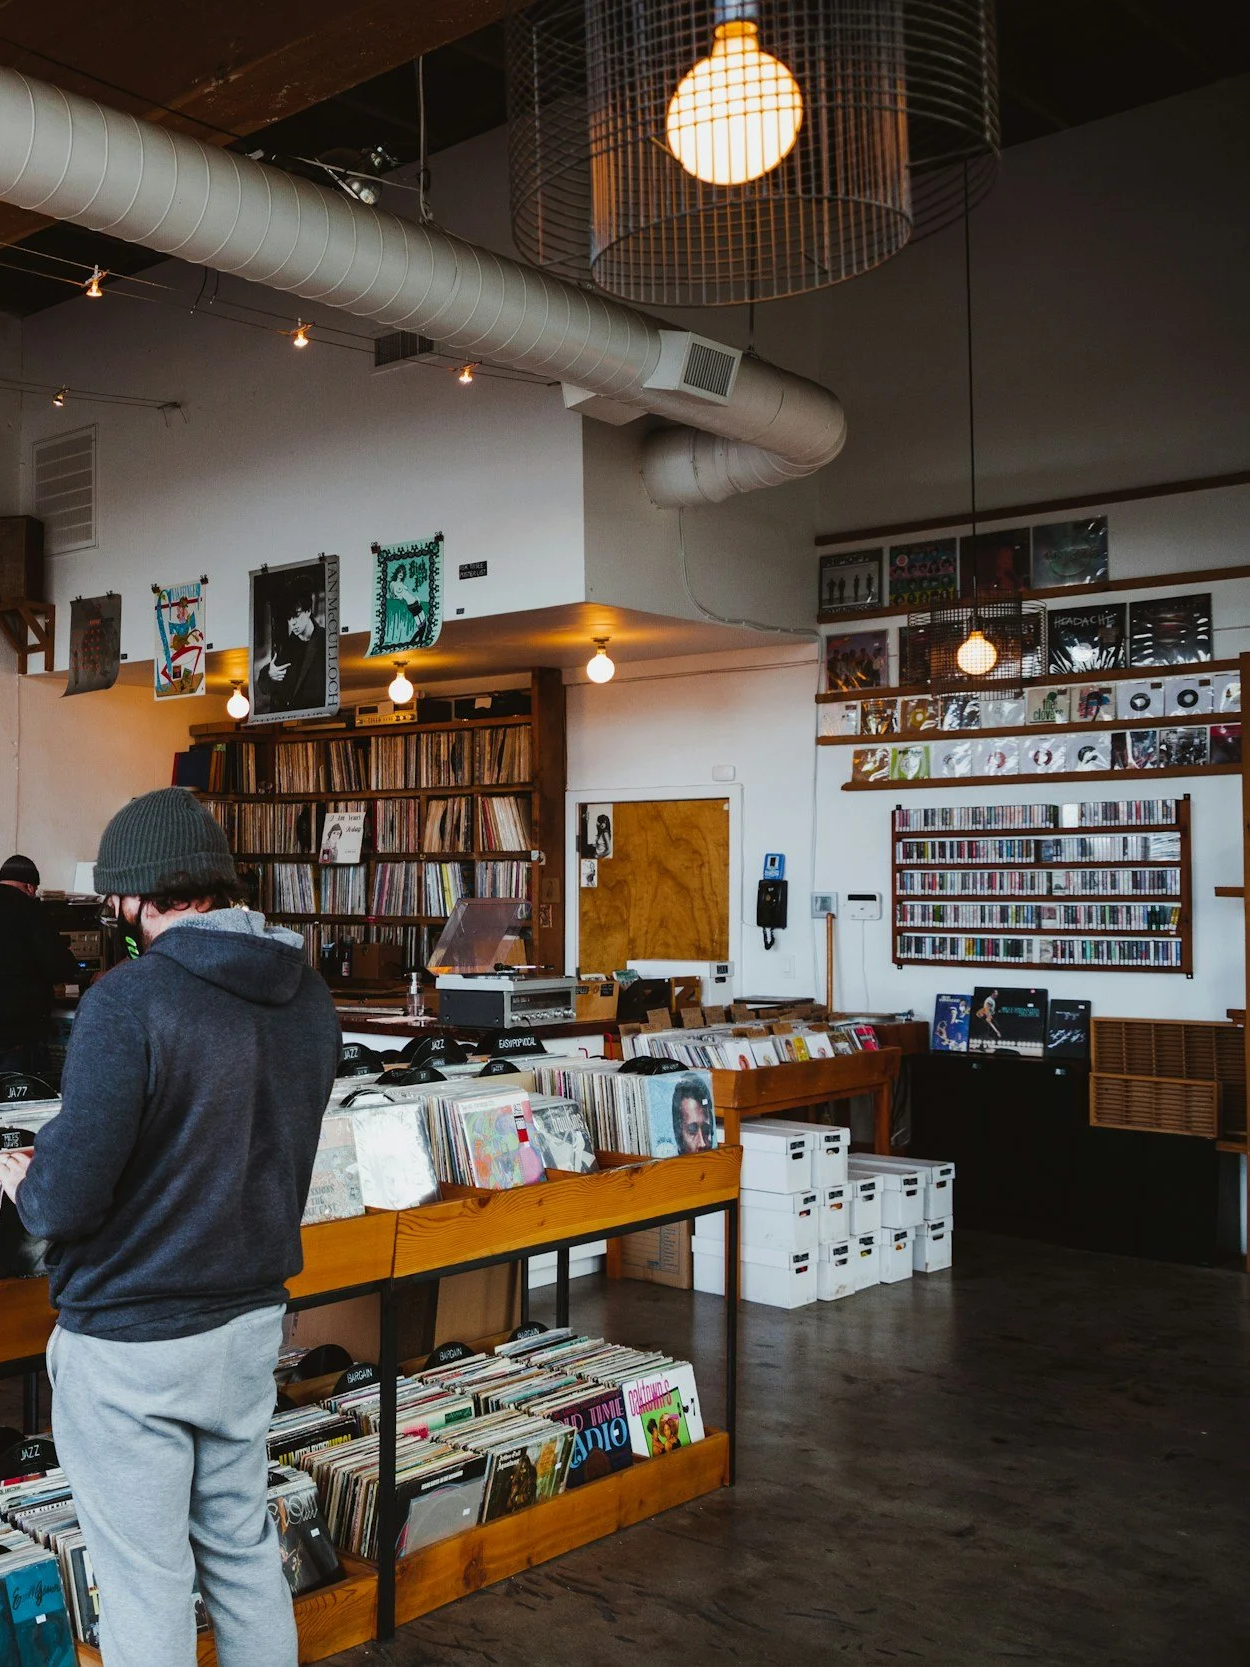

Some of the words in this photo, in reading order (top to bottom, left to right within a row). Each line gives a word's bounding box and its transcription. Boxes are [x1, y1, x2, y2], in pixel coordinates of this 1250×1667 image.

[327, 560, 338, 594] IAN
[1054, 613, 1116, 629] HEADACHE
[327, 597, 339, 707] McCULLOCH
[430, 1038, 445, 1051] JAZZ
[343, 1048, 359, 1060] JAZZ
[439, 1347, 463, 1361] BARGAIN
[347, 1368, 373, 1383] BARGAIN
[587, 1396, 626, 1427] TIME
[570, 1417, 629, 1470] ADIO
[20, 1444, 41, 1461] JAZZ
